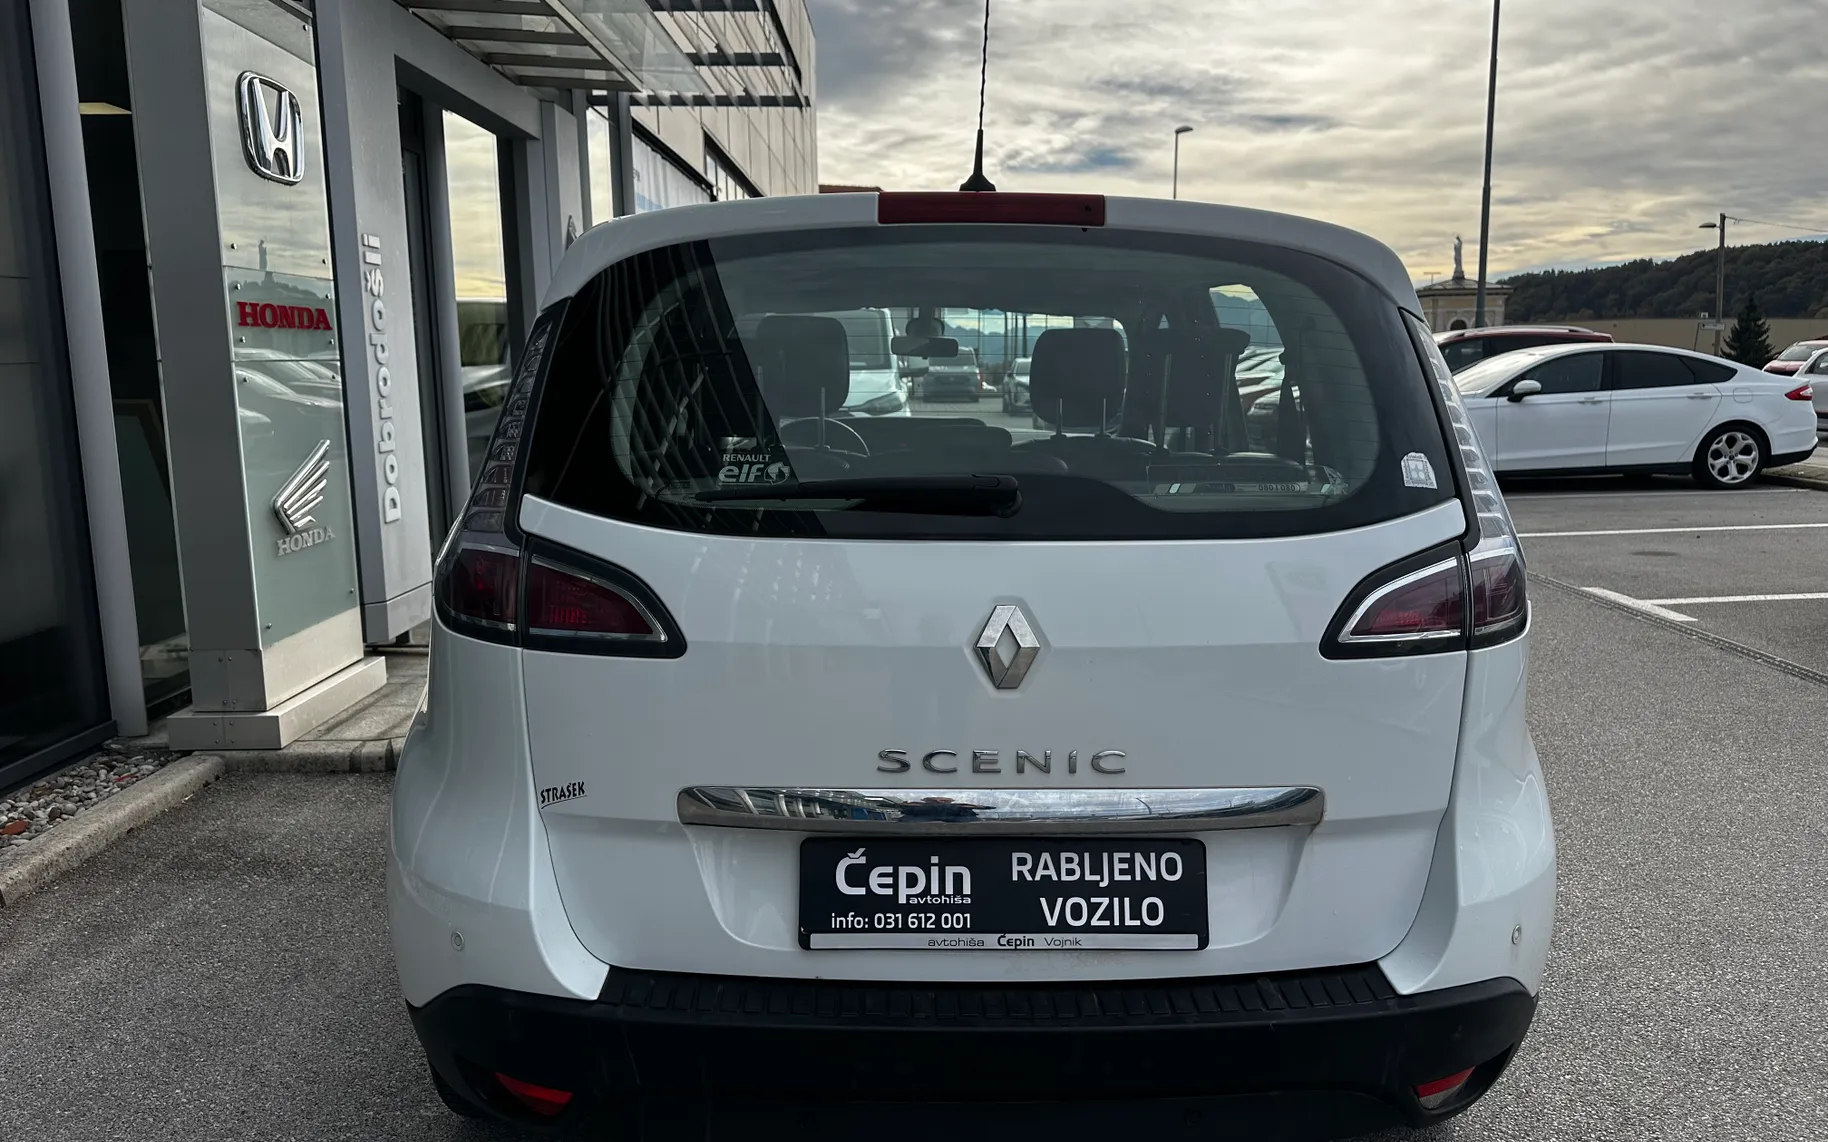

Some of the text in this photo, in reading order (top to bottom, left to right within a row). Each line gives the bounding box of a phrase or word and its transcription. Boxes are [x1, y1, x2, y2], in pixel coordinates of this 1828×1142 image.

[237, 301, 333, 331] HONDA
[362, 233, 401, 524] Dobrodošli
[722, 453, 771, 462] RENAULT
[718, 463, 765, 483] elf
[277, 526, 336, 556] HONDA
[877, 749, 1126, 774] SCENIC
[835, 847, 971, 904] Čepin
[1011, 851, 1183, 887] RABLJENO
[909, 895, 971, 904] avtohiša
[1039, 896, 1165, 926] VOZILO
[831, 912, 971, 929] info: 031 612 001
[927, 938, 985, 947] avtohiša
[1044, 936, 1082, 948] Vojnik
